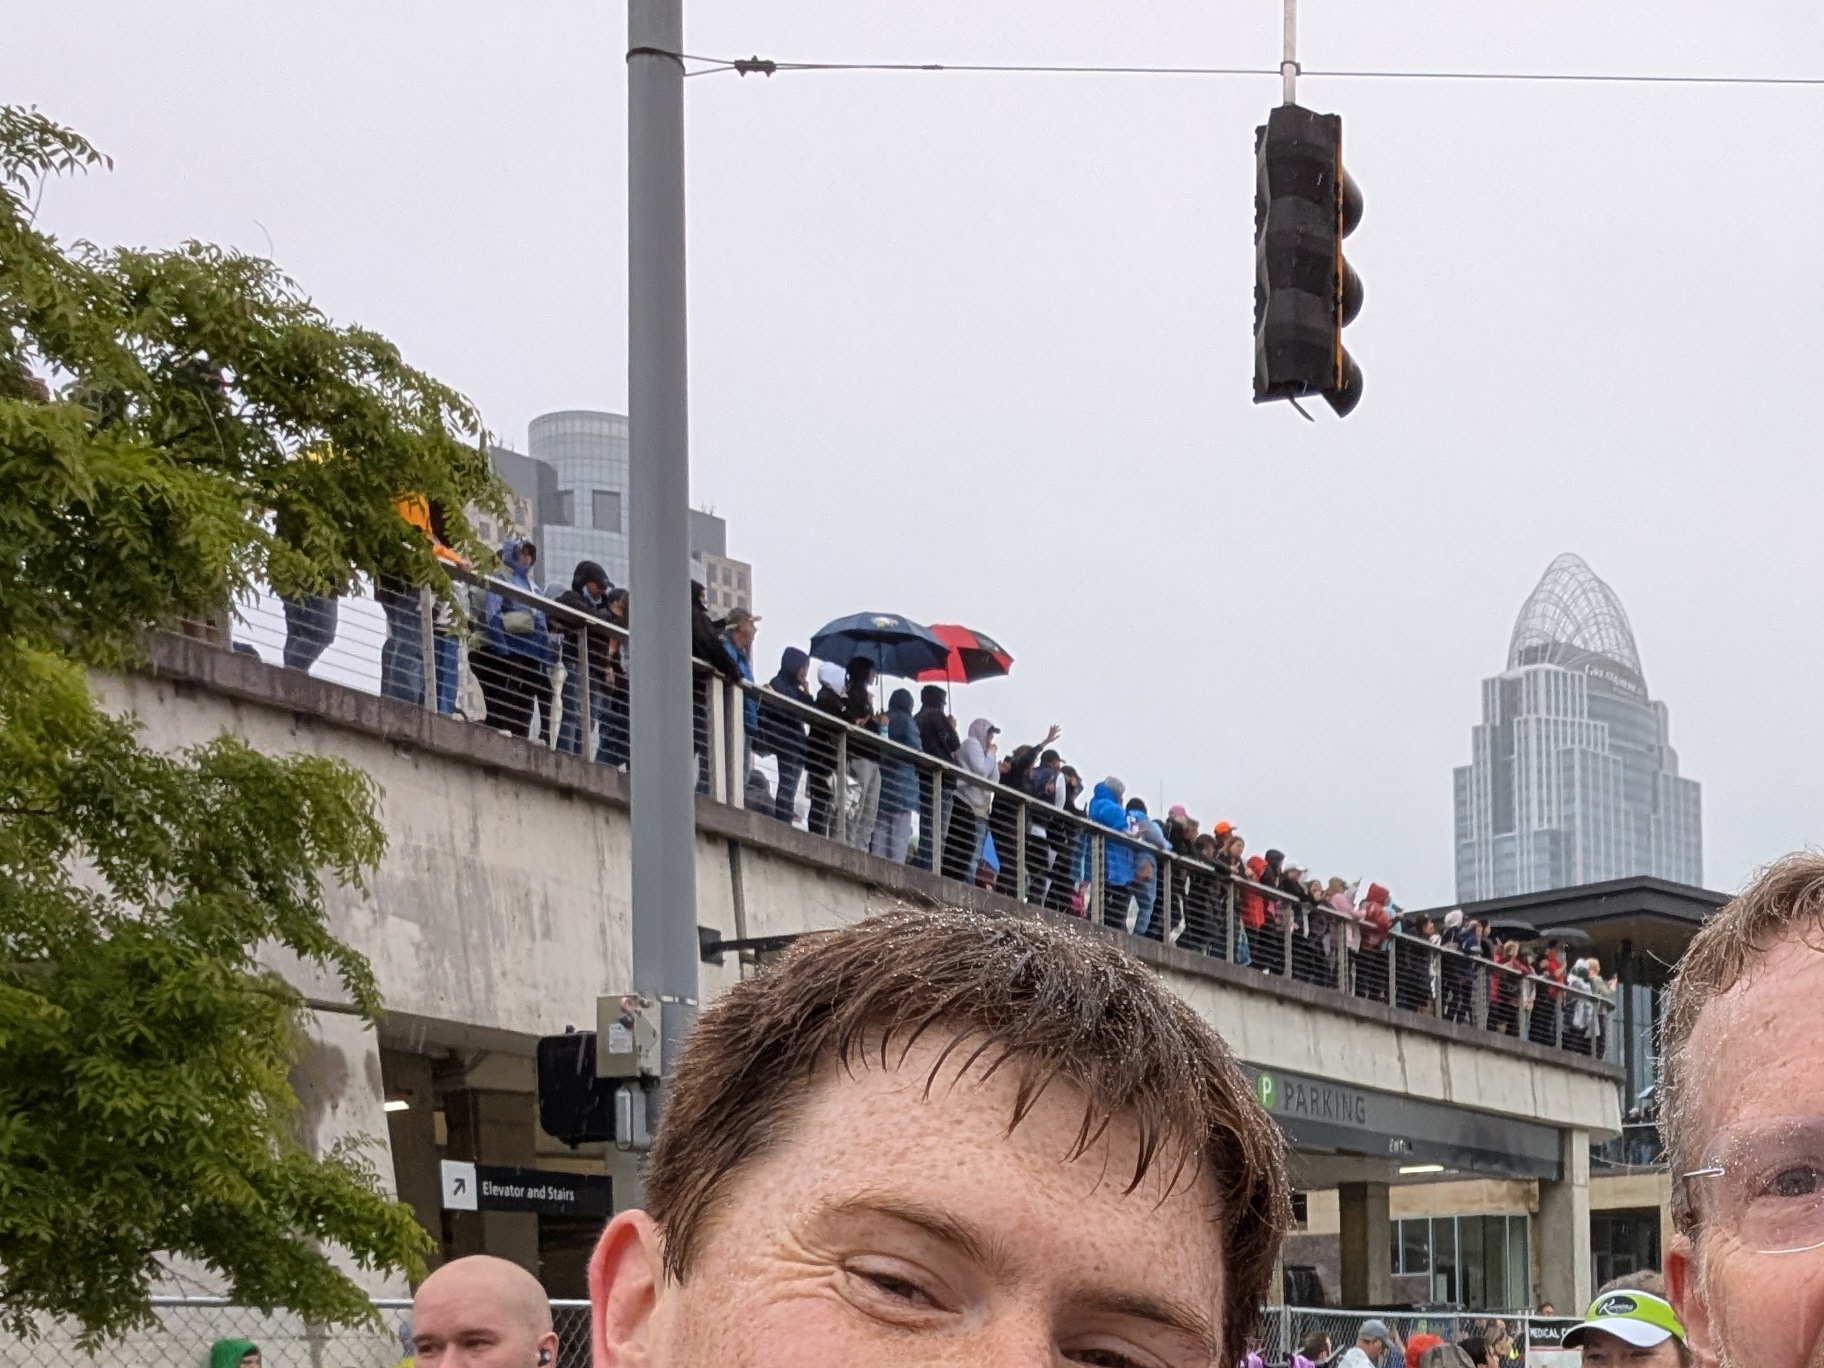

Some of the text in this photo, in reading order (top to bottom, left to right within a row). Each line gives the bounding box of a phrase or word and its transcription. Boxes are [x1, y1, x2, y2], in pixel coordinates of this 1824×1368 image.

[1284, 1081, 1366, 1124] PARKING
[482, 1180, 575, 1202] Elevator and Stairs
[1530, 1327, 1560, 1338] MEDICAL
